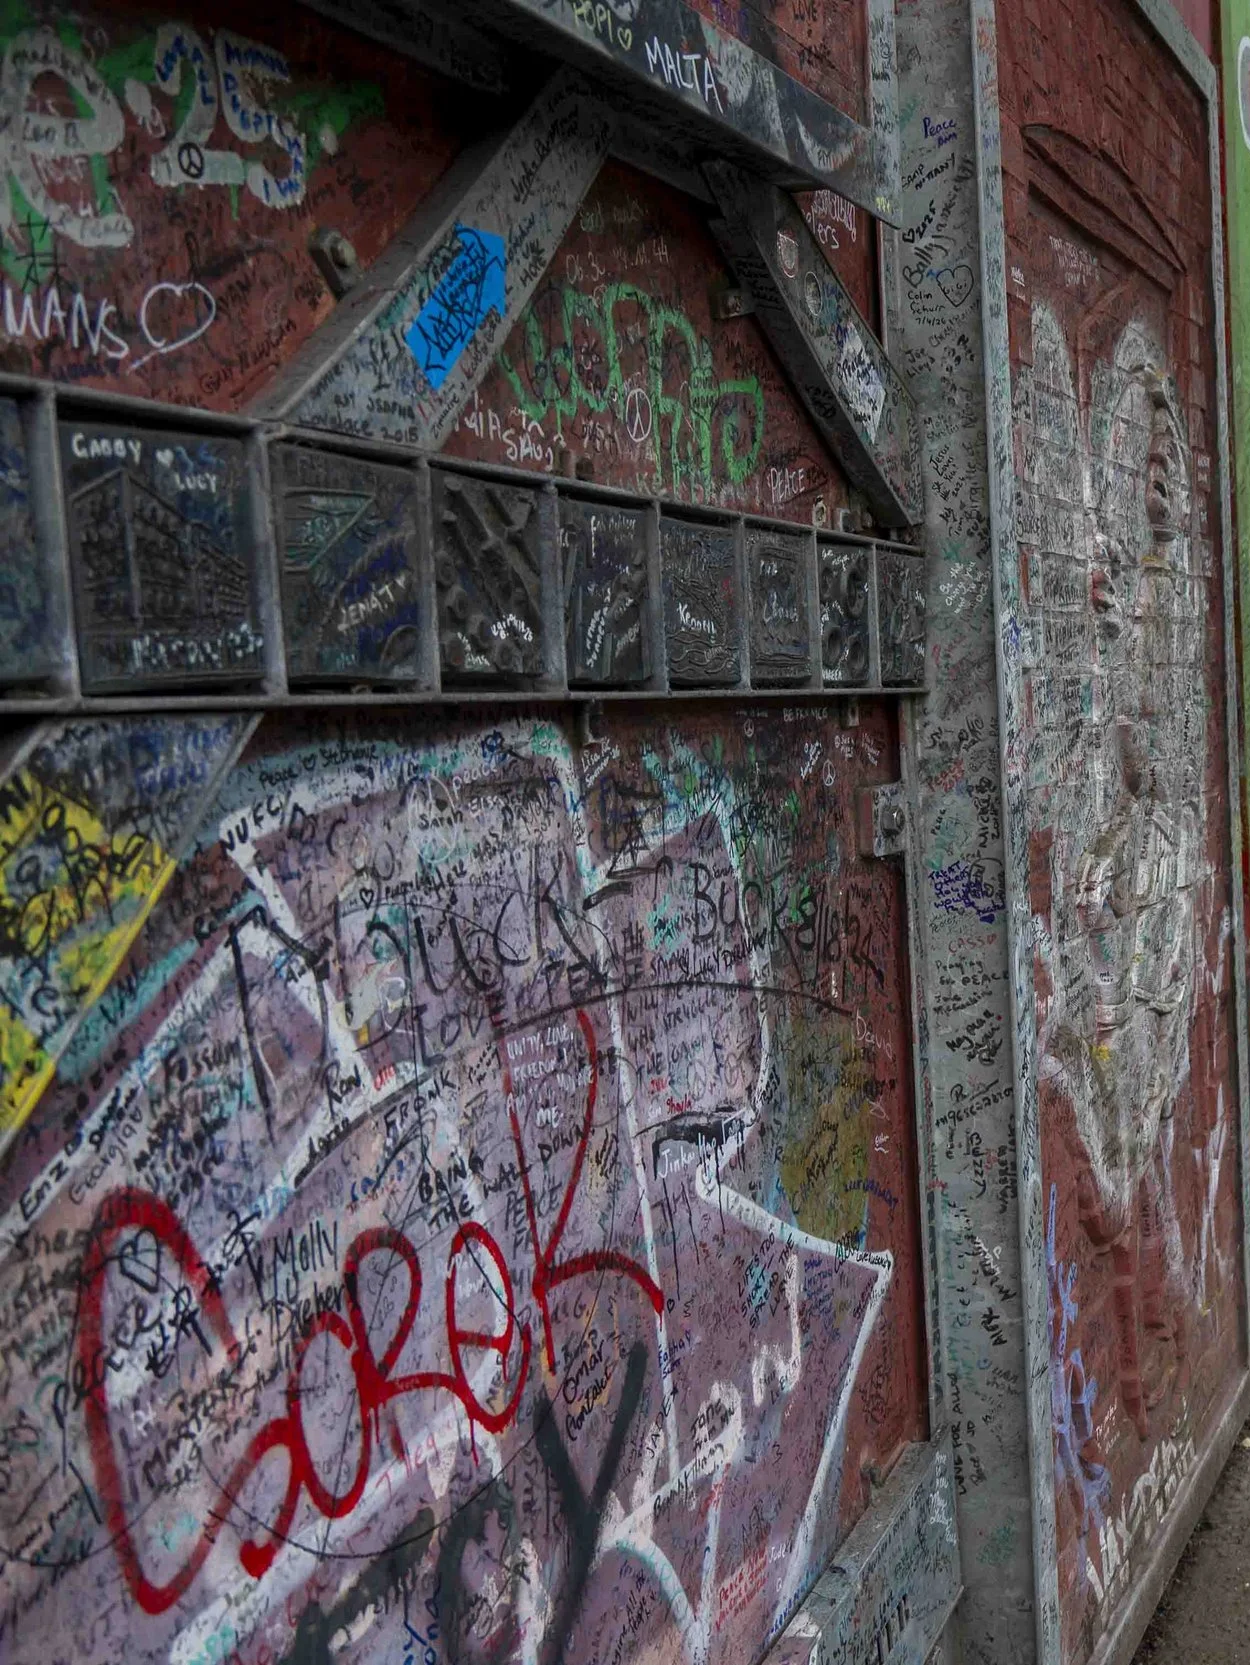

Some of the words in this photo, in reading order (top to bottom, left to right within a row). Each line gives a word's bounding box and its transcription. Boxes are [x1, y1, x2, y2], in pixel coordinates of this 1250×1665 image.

[644, 35, 724, 115] MALTA
[923, 116, 957, 138] Peace
[907, 290, 933, 300] Colin
[173, 471, 218, 494] LUCY
[767, 467, 806, 502] PEACE
[562, 1338, 606, 1405] Omar
